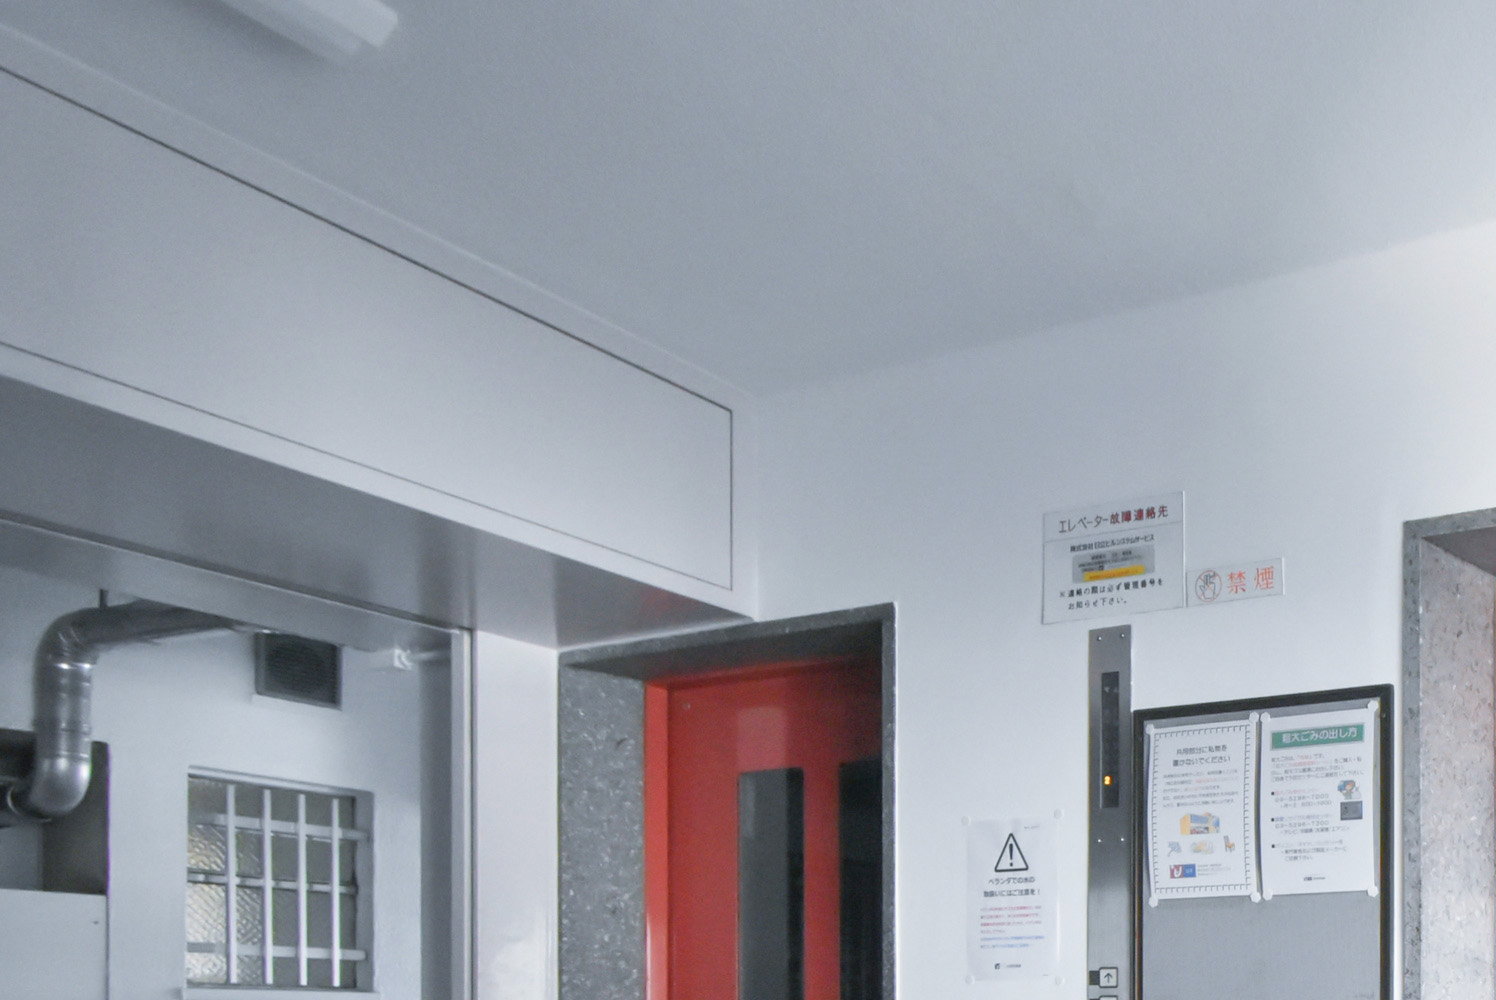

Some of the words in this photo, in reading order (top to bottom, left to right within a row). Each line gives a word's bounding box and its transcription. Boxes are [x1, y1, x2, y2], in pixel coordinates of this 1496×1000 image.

[1059, 505, 1168, 533] エレベーター故障連絡先
[1227, 565, 1274, 594] 禁煙
